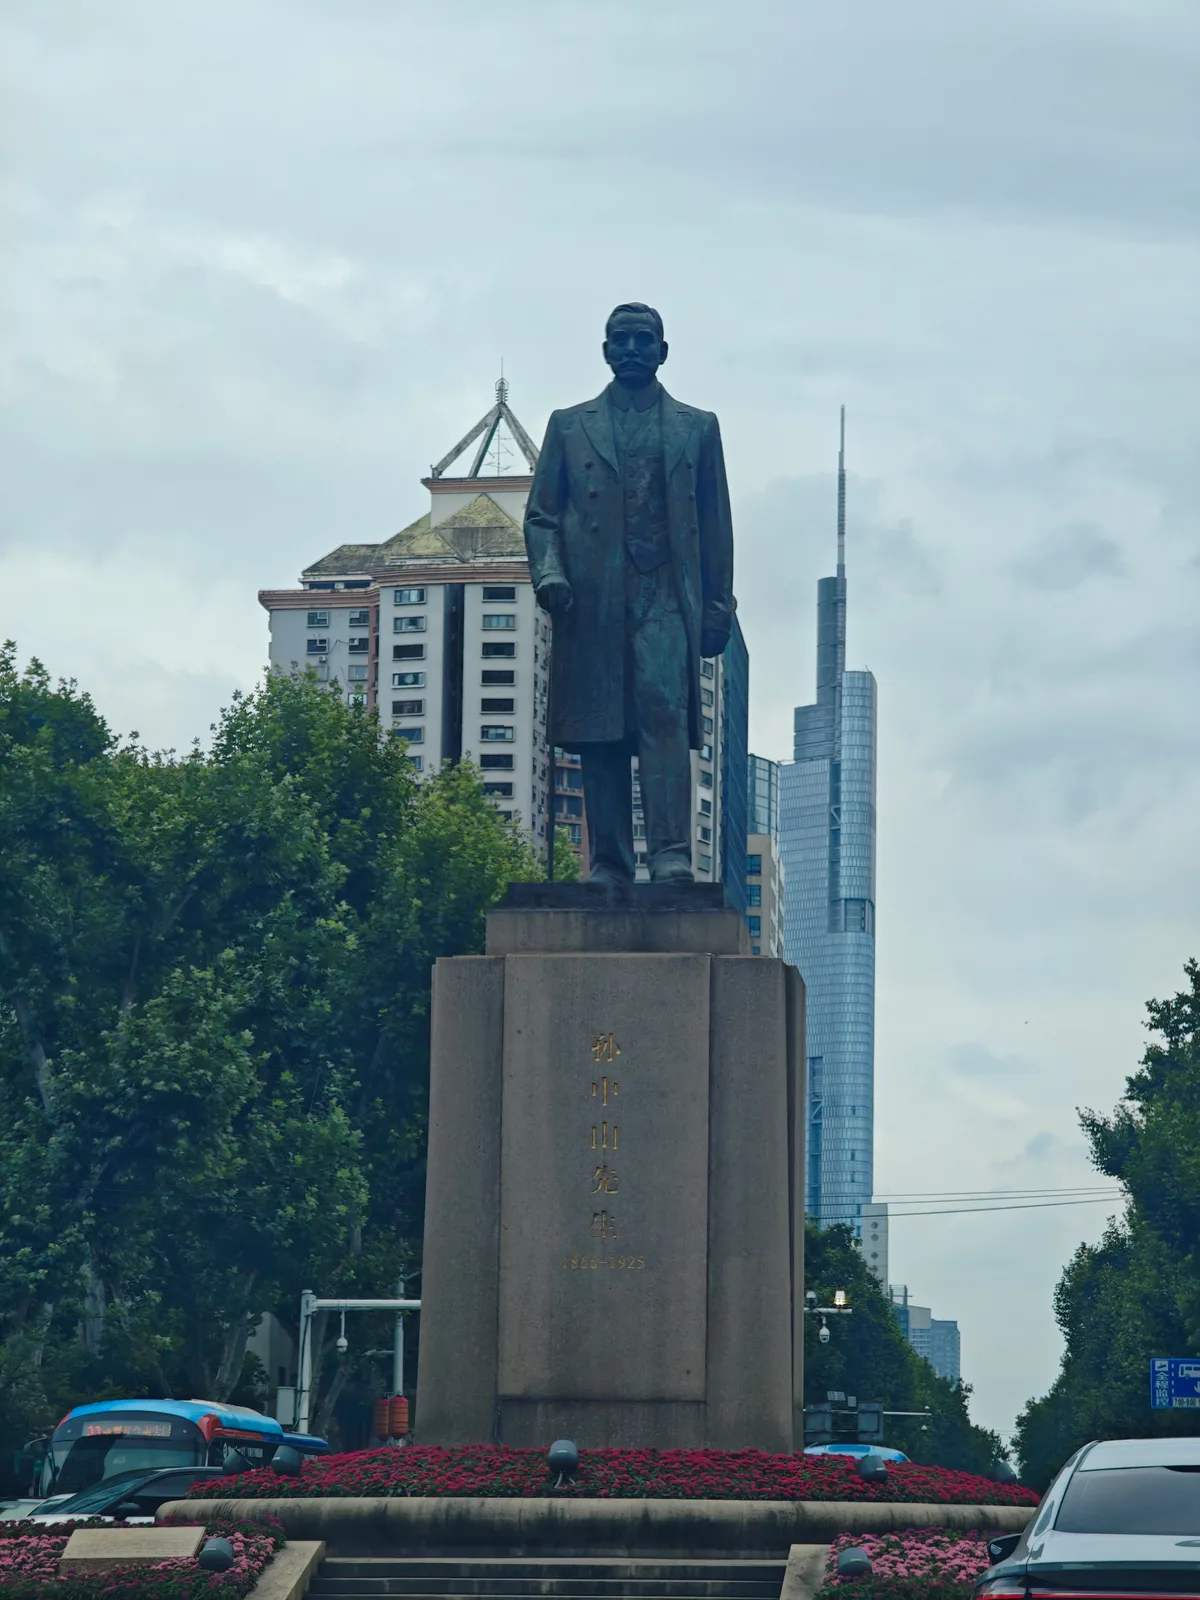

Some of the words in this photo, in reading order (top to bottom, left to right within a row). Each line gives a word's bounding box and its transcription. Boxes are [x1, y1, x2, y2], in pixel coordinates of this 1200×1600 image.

[590, 1032, 621, 1239] 孙中山先生
[1155, 1372, 1169, 1406] 全程监控
